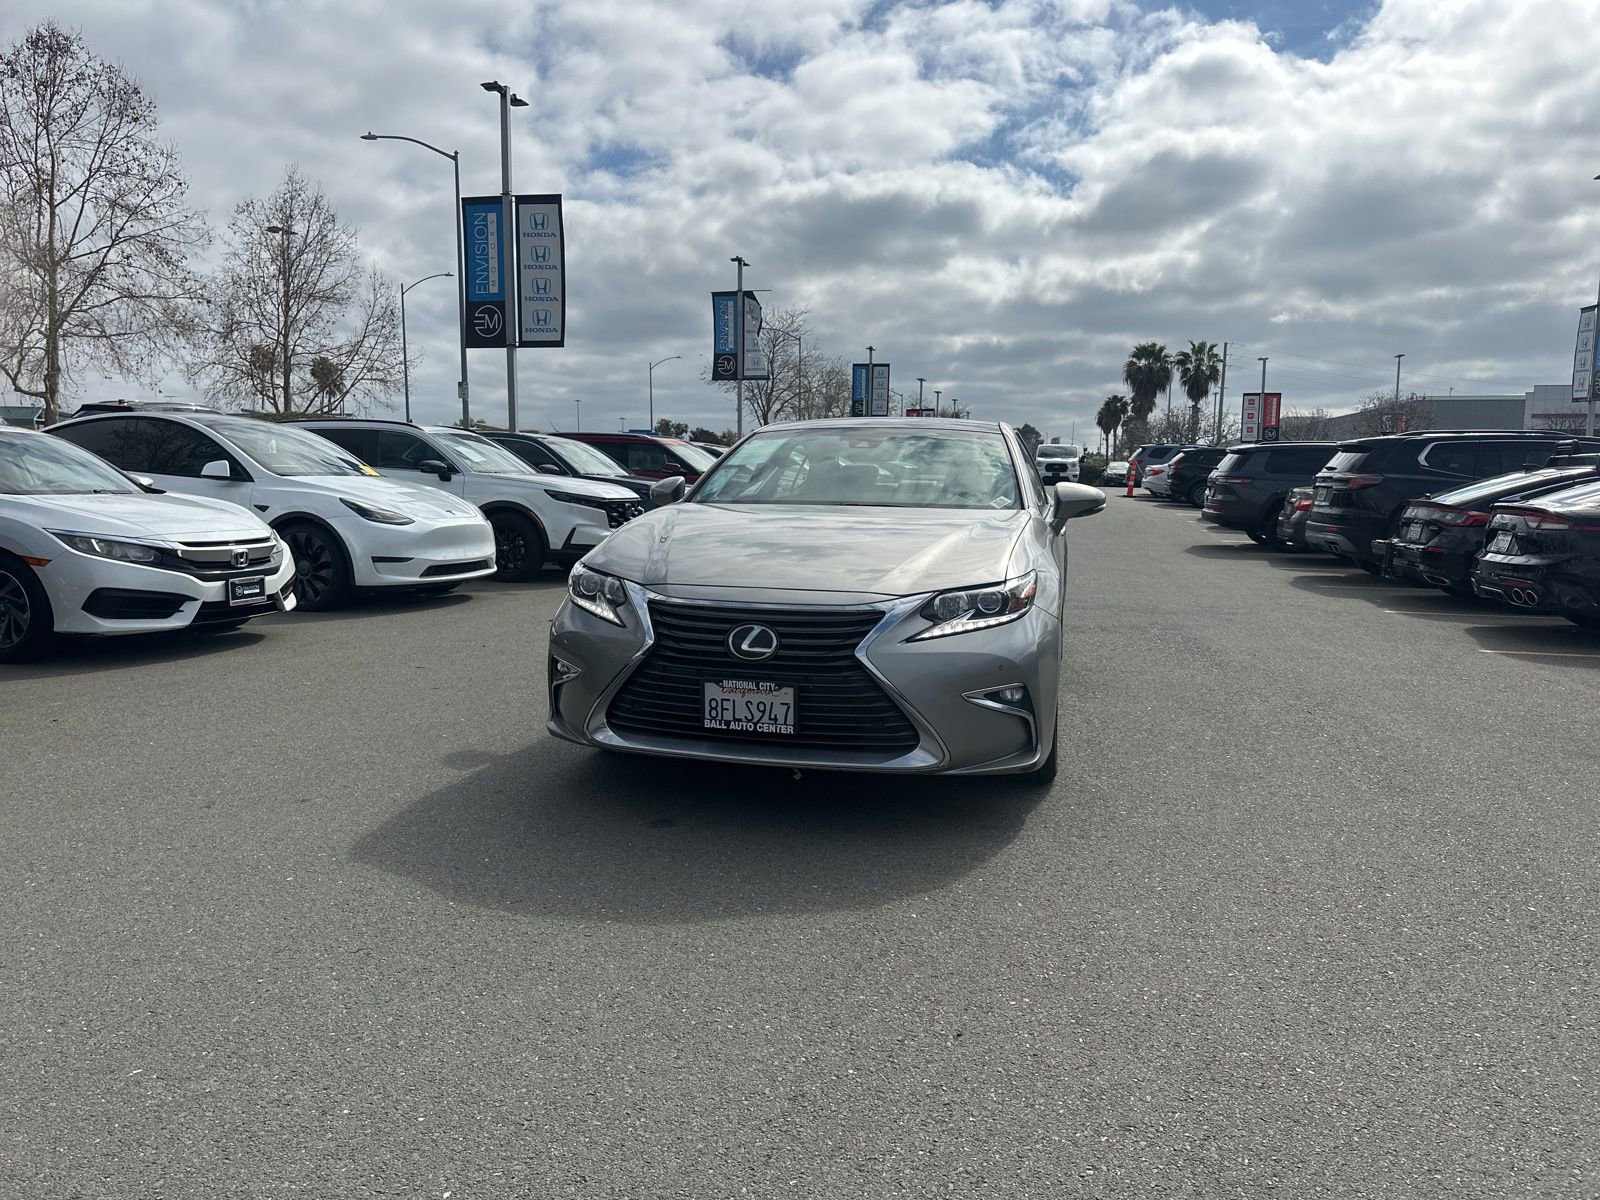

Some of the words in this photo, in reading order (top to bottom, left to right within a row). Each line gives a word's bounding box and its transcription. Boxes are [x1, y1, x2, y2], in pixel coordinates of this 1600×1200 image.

[474, 212, 489, 294] ENVISION
[720, 301, 728, 350] ENVISION
[723, 680, 757, 689] NATIONAL
[759, 682, 775, 690] CITY
[708, 697, 791, 725] 8FLS947
[704, 719, 727, 729] BALL
[729, 722, 754, 731] AUTO
[756, 724, 794, 734] CENTER
